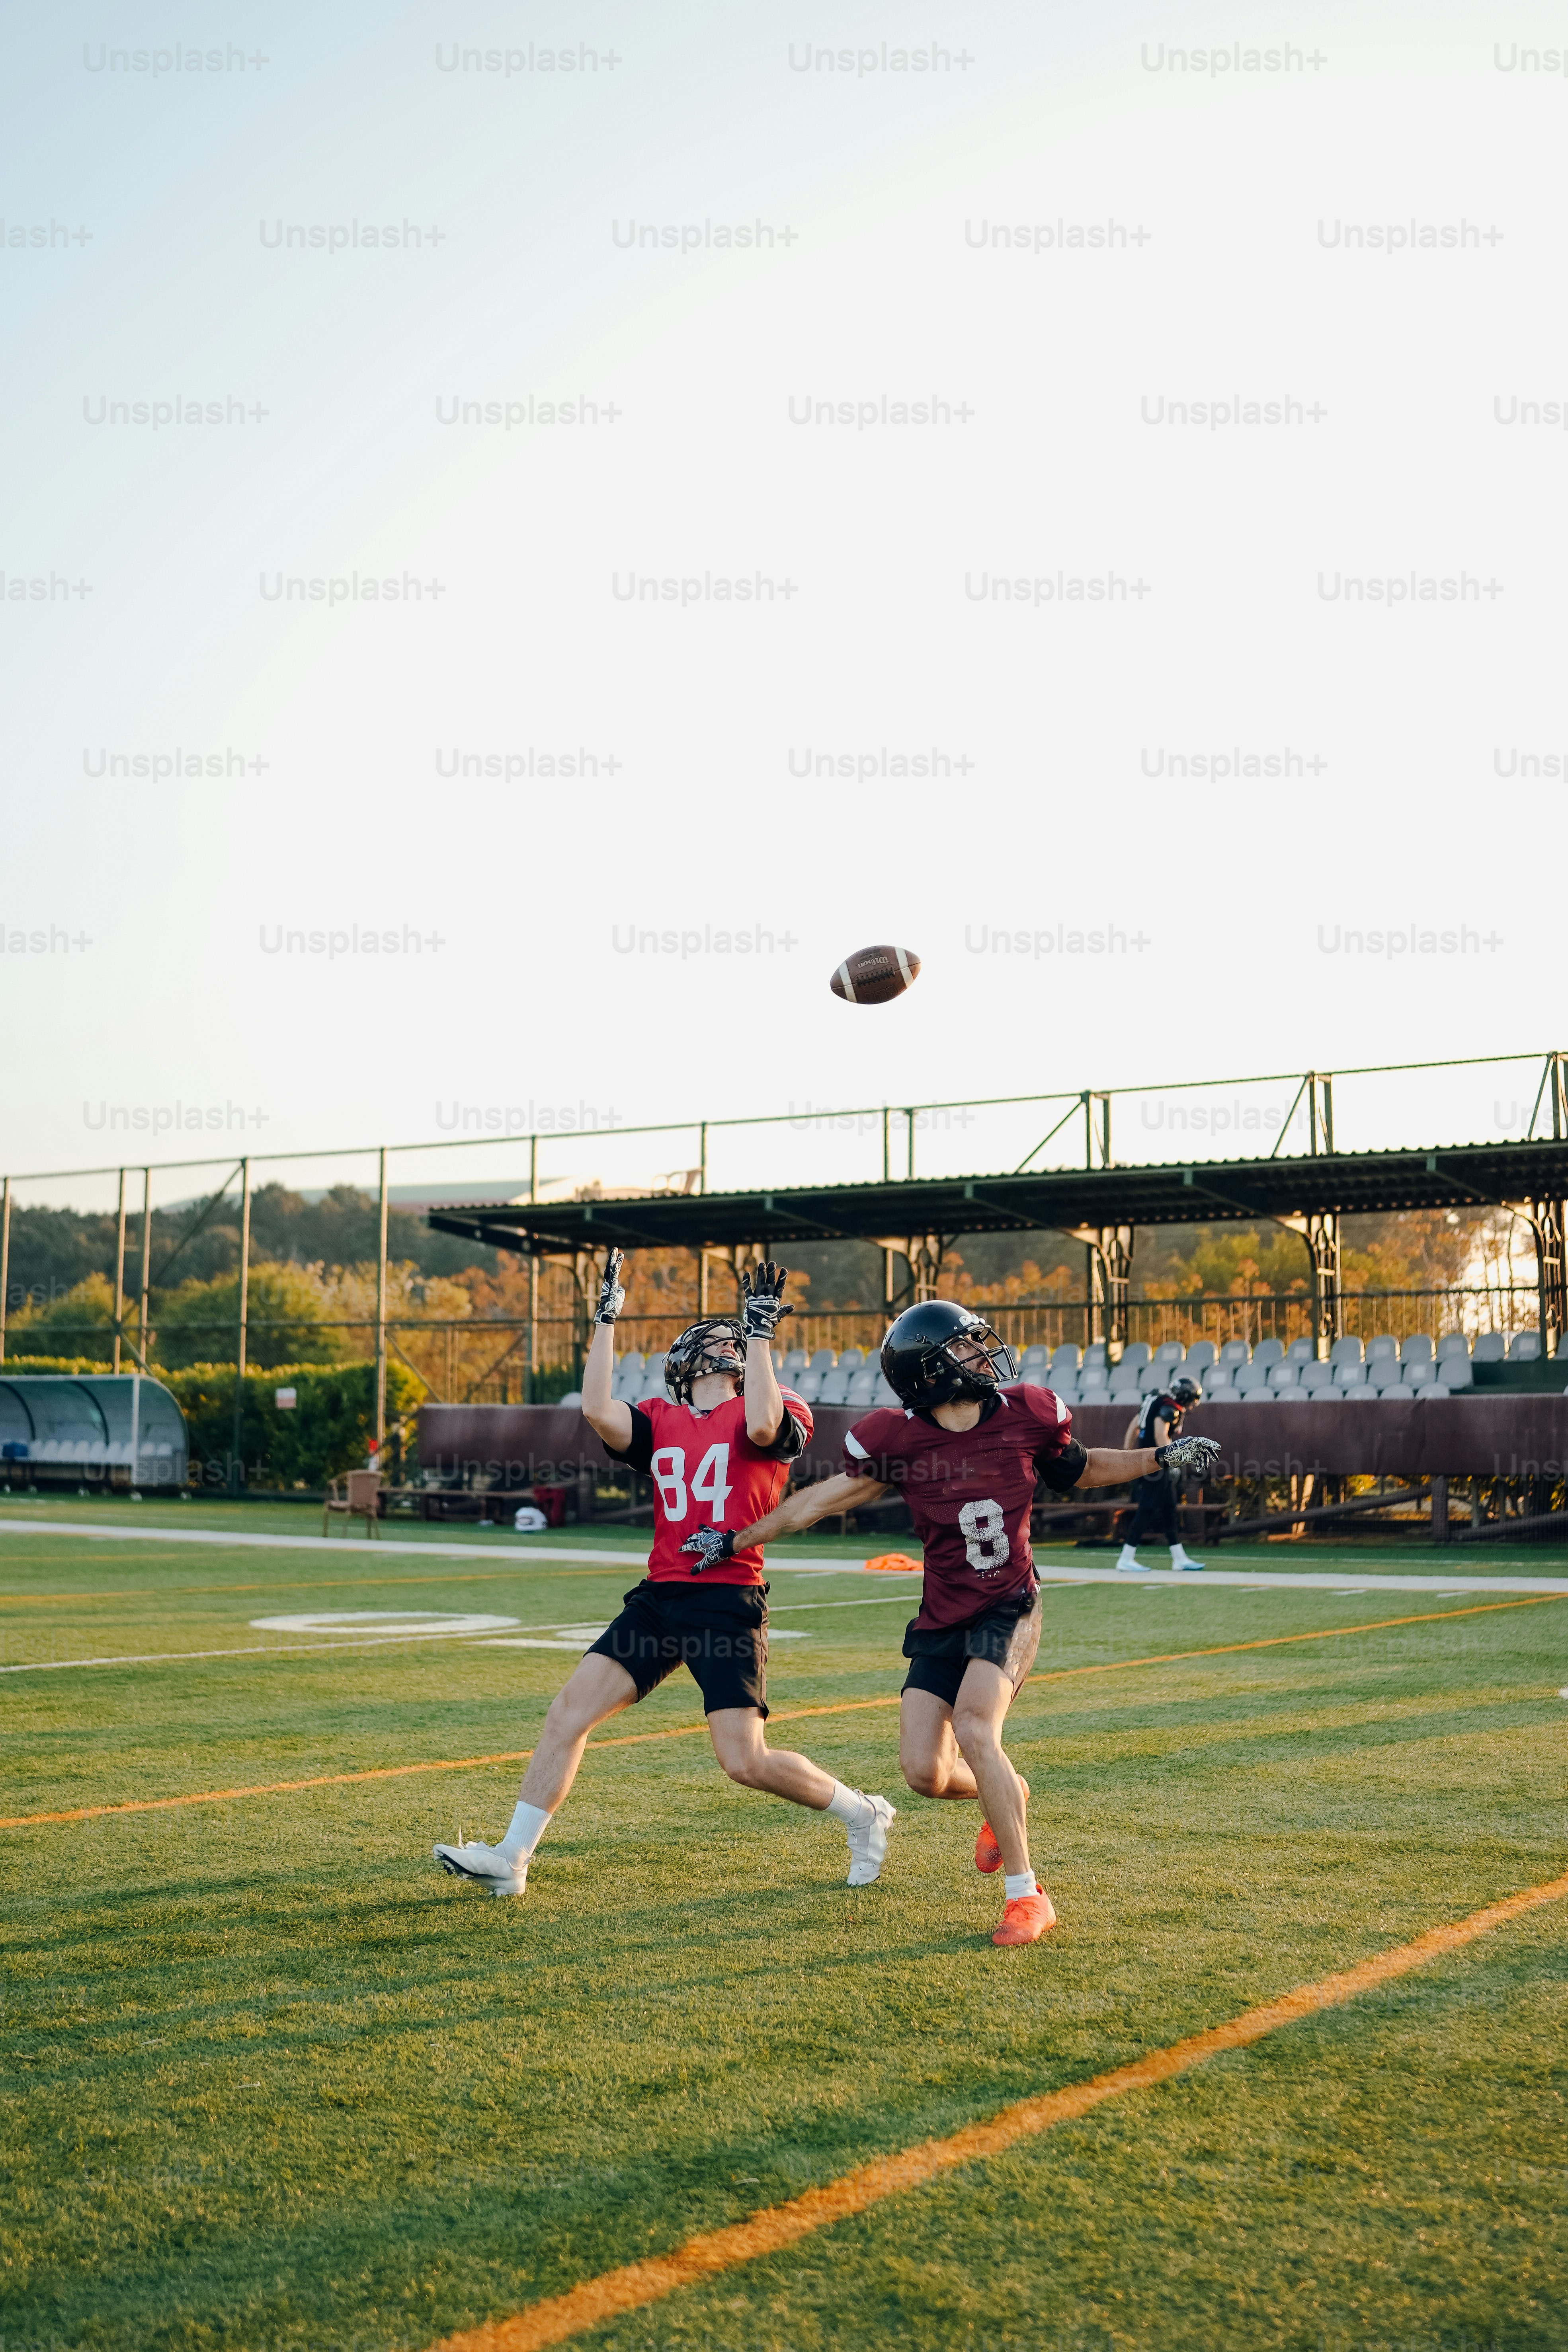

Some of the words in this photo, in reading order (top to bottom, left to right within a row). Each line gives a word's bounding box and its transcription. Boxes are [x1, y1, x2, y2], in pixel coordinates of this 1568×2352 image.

[857, 956, 890, 968] Wilson
[650, 1443, 733, 1523] 84
[958, 1498, 1010, 1571] 8
